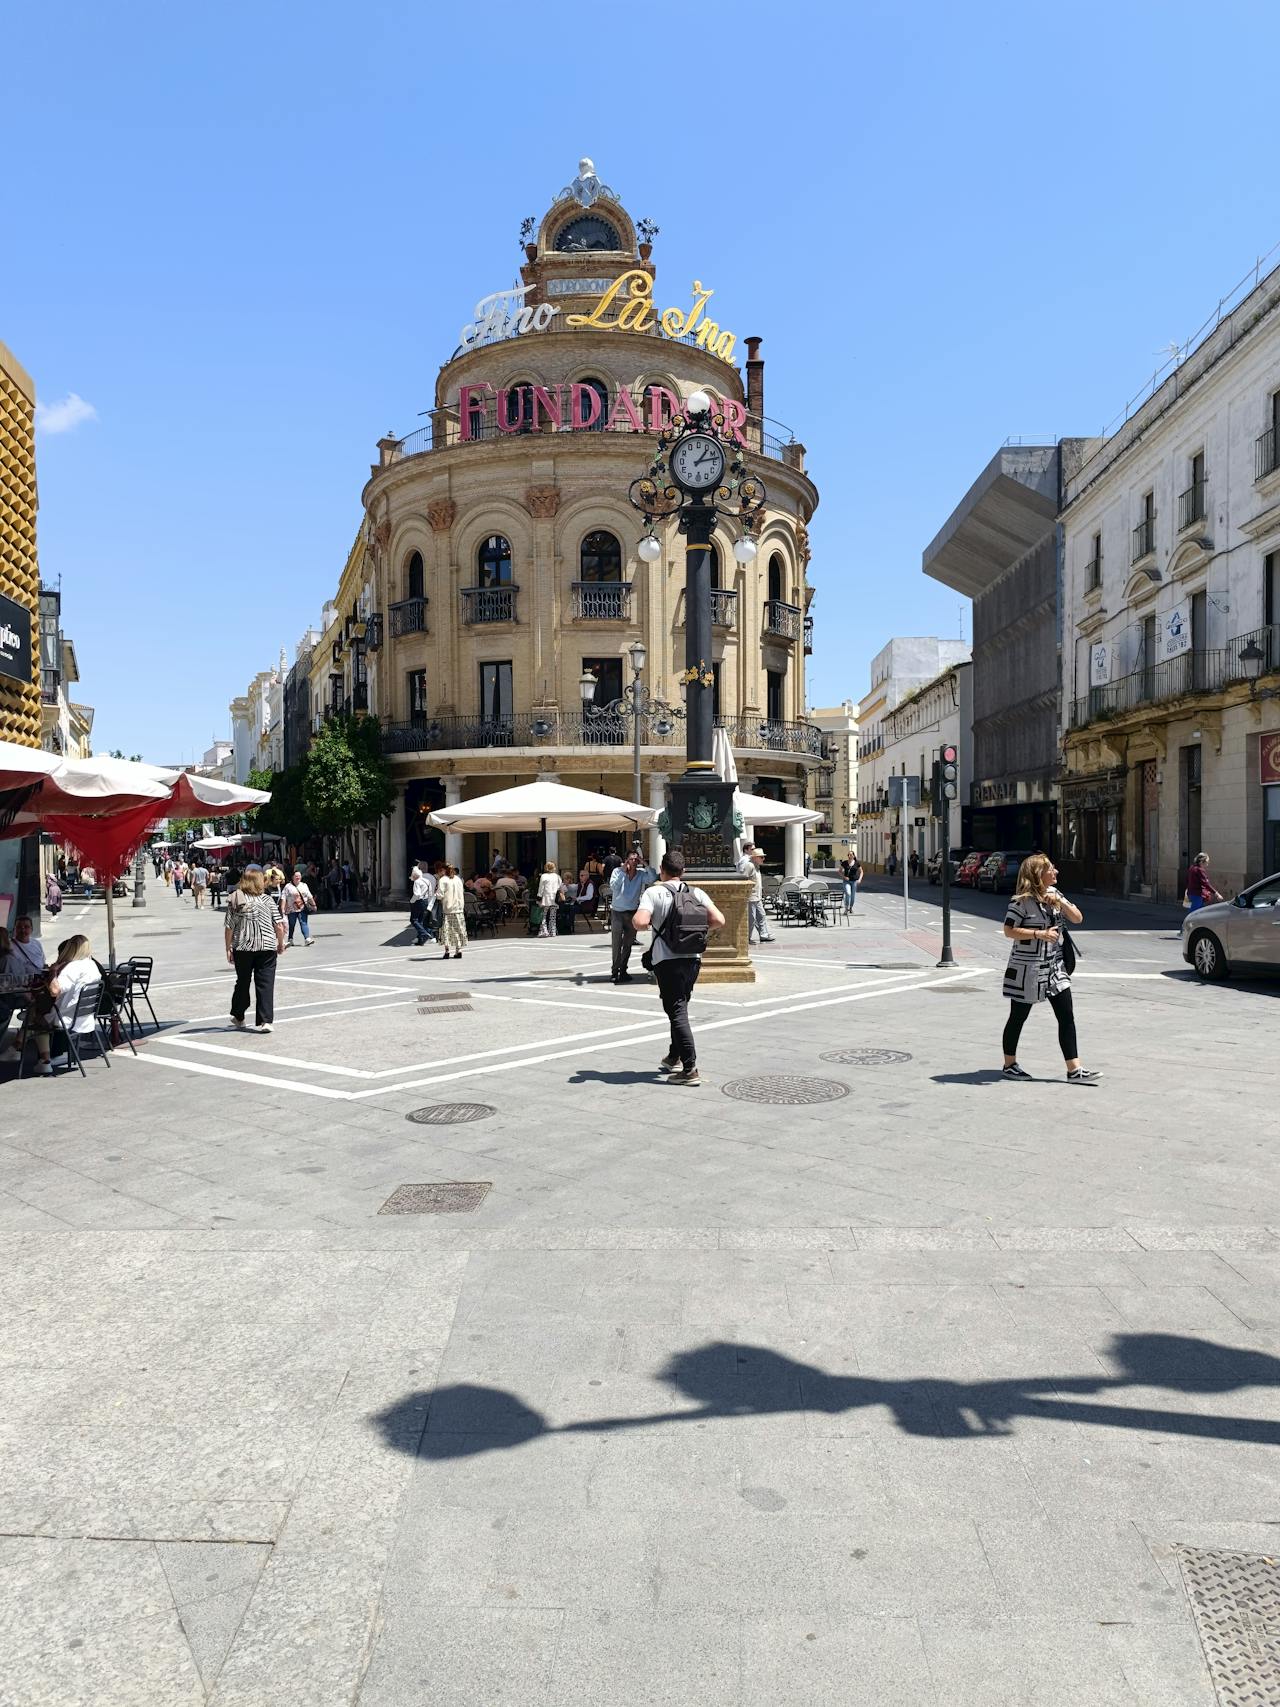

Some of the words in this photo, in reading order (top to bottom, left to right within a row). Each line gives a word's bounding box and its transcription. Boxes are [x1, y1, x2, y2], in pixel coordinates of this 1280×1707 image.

[460, 284, 560, 347] Fino
[566, 269, 655, 331] La
[662, 280, 737, 365] Ina
[683, 833, 723, 842] PEDRO
